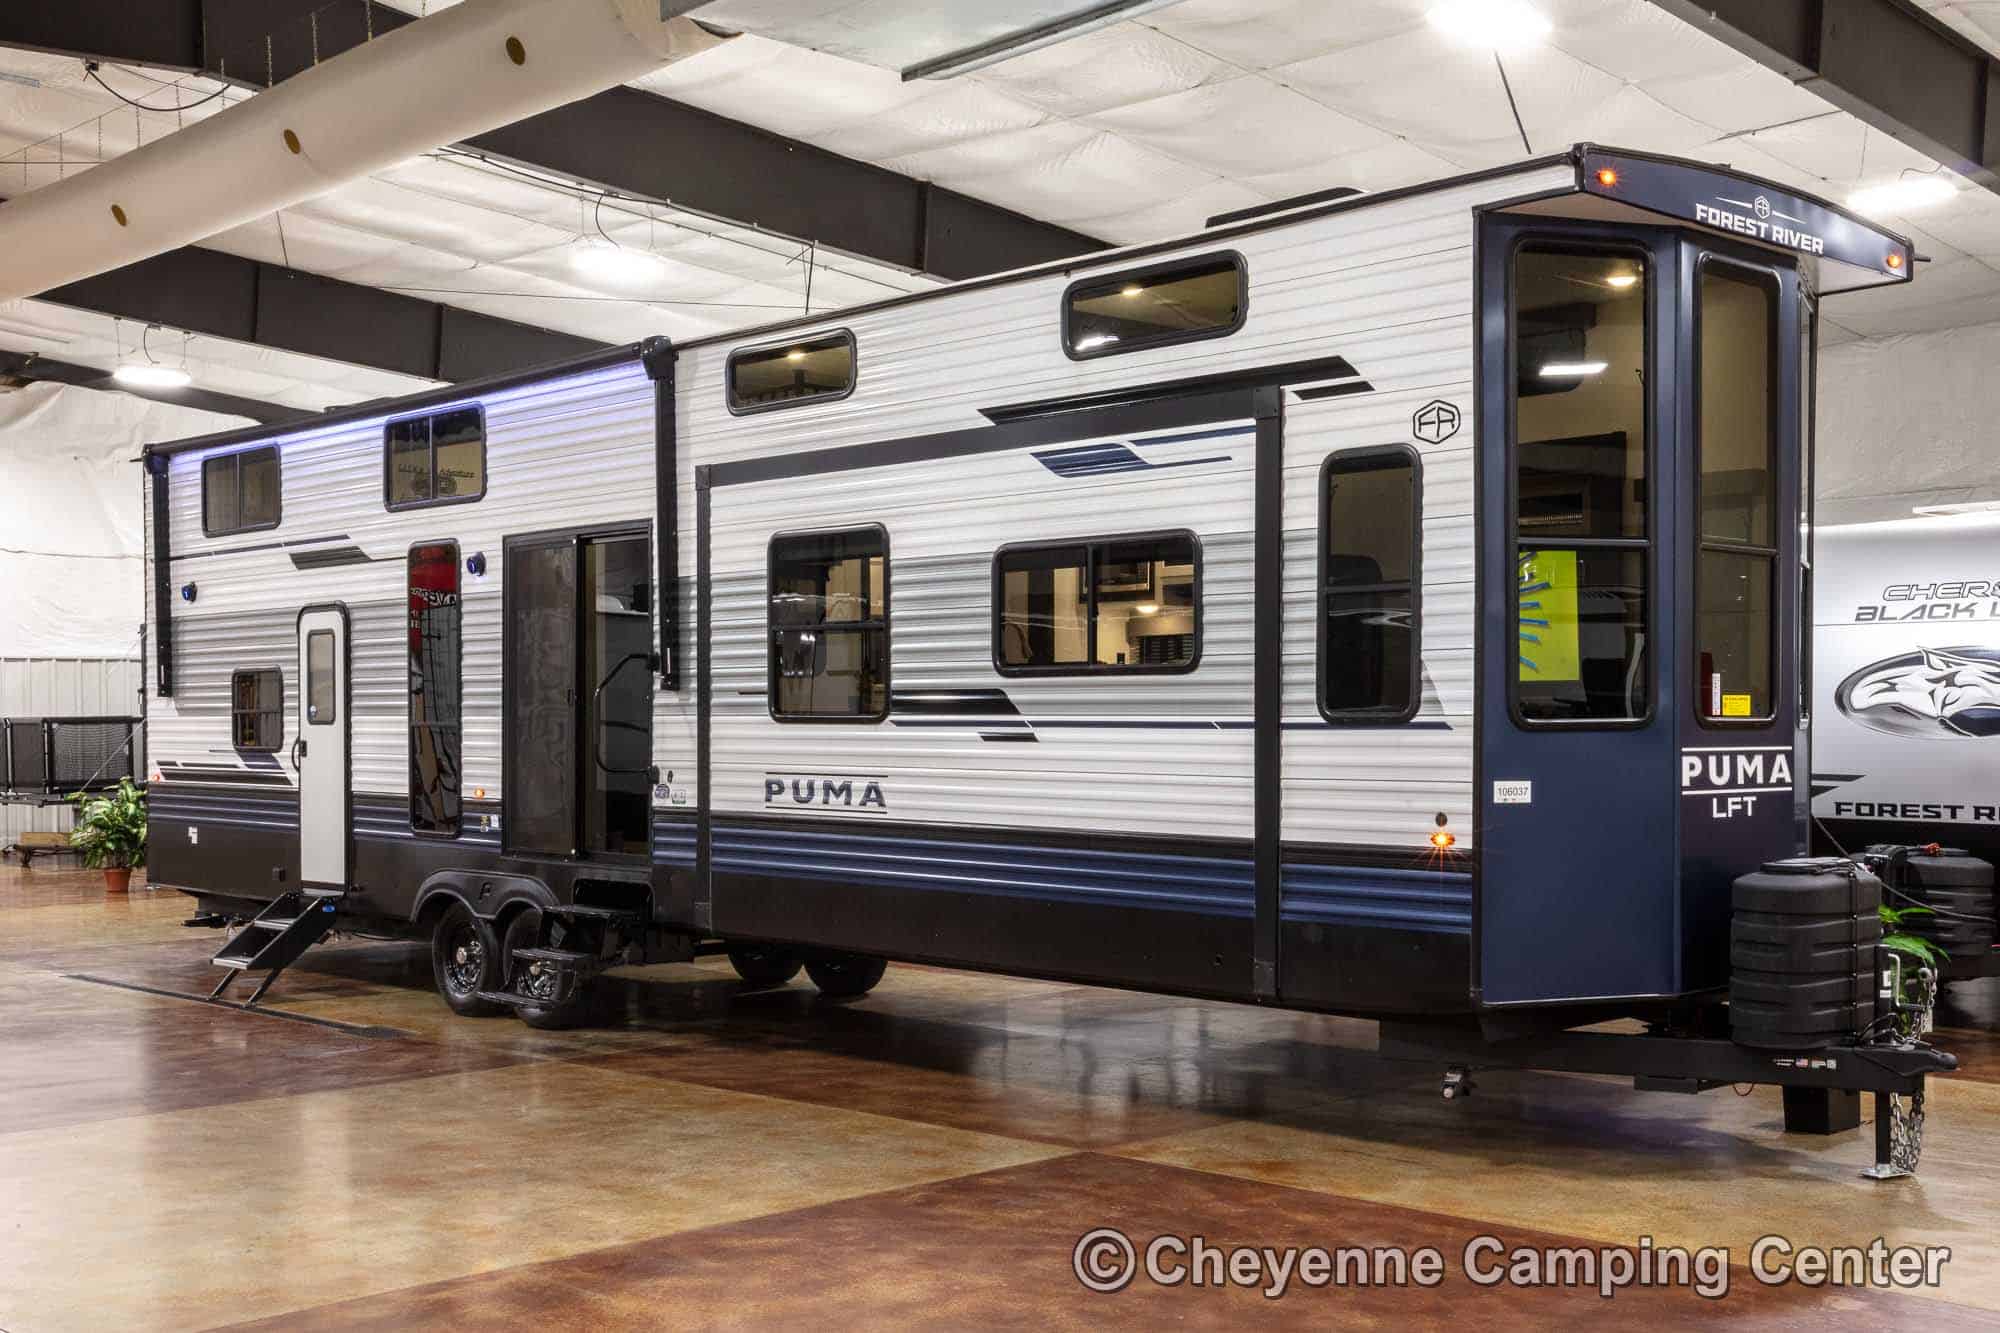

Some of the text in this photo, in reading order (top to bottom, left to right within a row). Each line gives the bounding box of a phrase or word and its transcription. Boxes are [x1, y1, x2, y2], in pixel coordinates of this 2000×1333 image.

[1696, 203, 1824, 254] FOREST RIVER
[1855, 602, 1978, 621] BLACK
[1681, 753, 1792, 787] PUMA
[765, 778, 887, 807] PUMA
[1497, 786, 1529, 797] 106037
[1712, 796, 1757, 818] LFT
[1834, 801, 2000, 821] FOREST R
